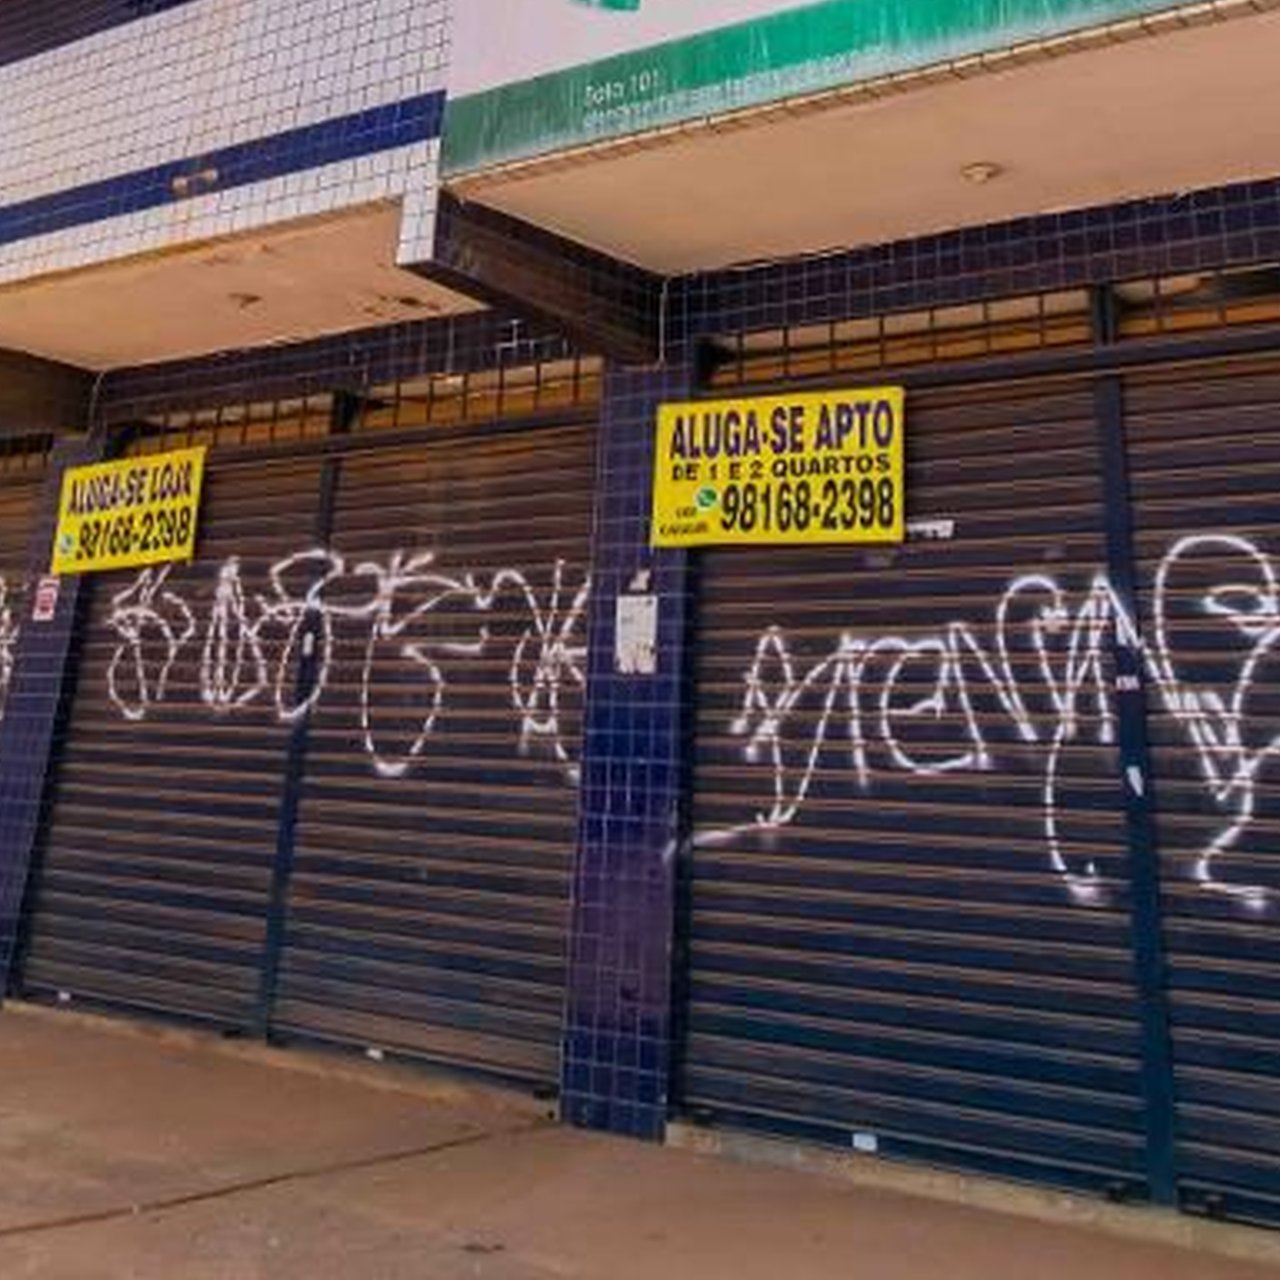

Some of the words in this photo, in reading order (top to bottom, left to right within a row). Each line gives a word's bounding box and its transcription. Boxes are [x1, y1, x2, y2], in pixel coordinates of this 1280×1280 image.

[670, 405, 805, 459] ALUGA-SE
[815, 399, 894, 450] APTO
[672, 462, 699, 481] DE
[708, 462, 719, 480] 1
[728, 461, 741, 480] E
[749, 461, 765, 479] 2
[772, 453, 891, 478] QUARTOS
[721, 477, 895, 532] 98168-2398
